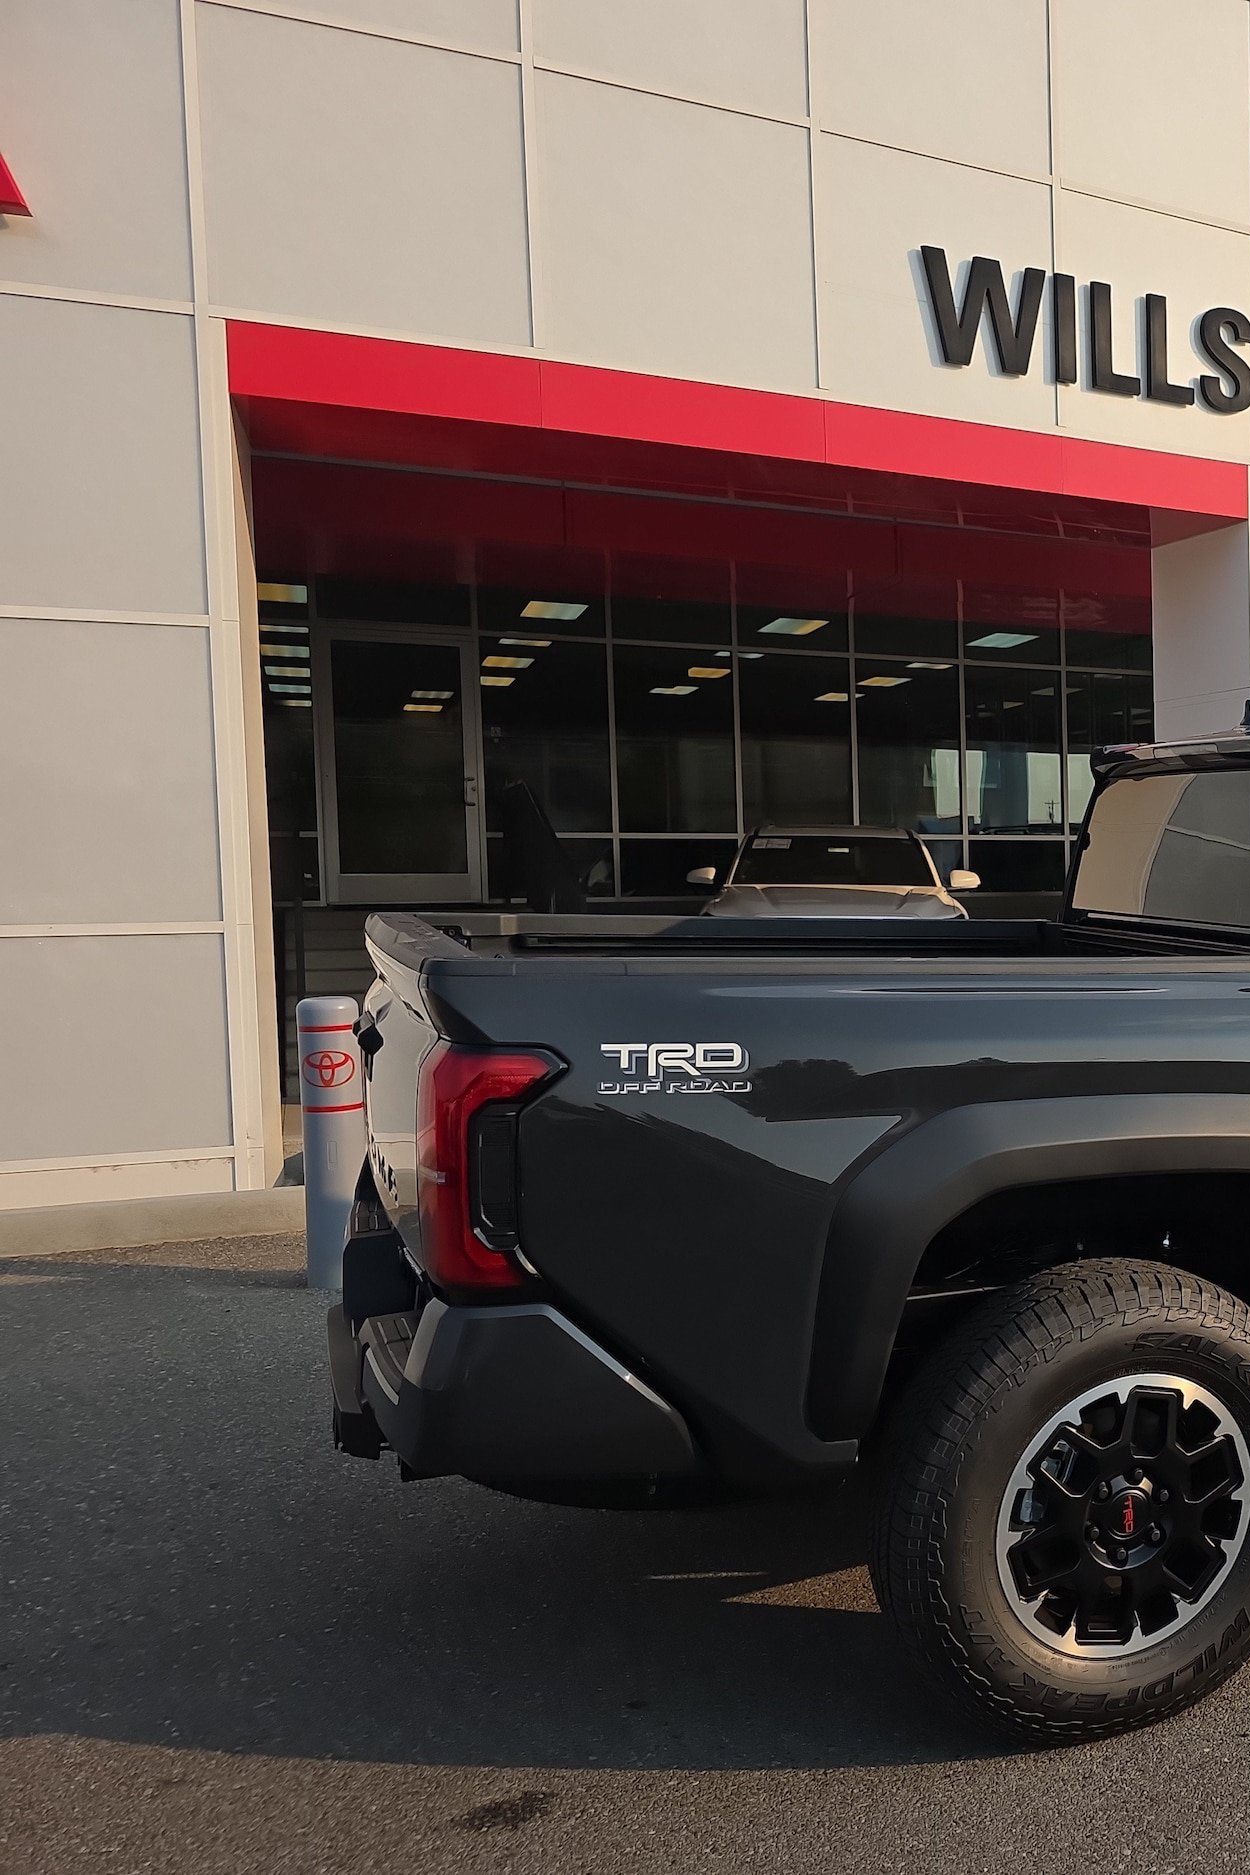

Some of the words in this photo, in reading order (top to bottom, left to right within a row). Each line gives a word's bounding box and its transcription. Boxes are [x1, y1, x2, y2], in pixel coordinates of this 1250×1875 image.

[600, 1043, 750, 1081] TRD
[598, 1081, 661, 1094] OFF
[665, 1079, 752, 1094] ROAD
[1122, 1495, 1135, 1534] TRD
